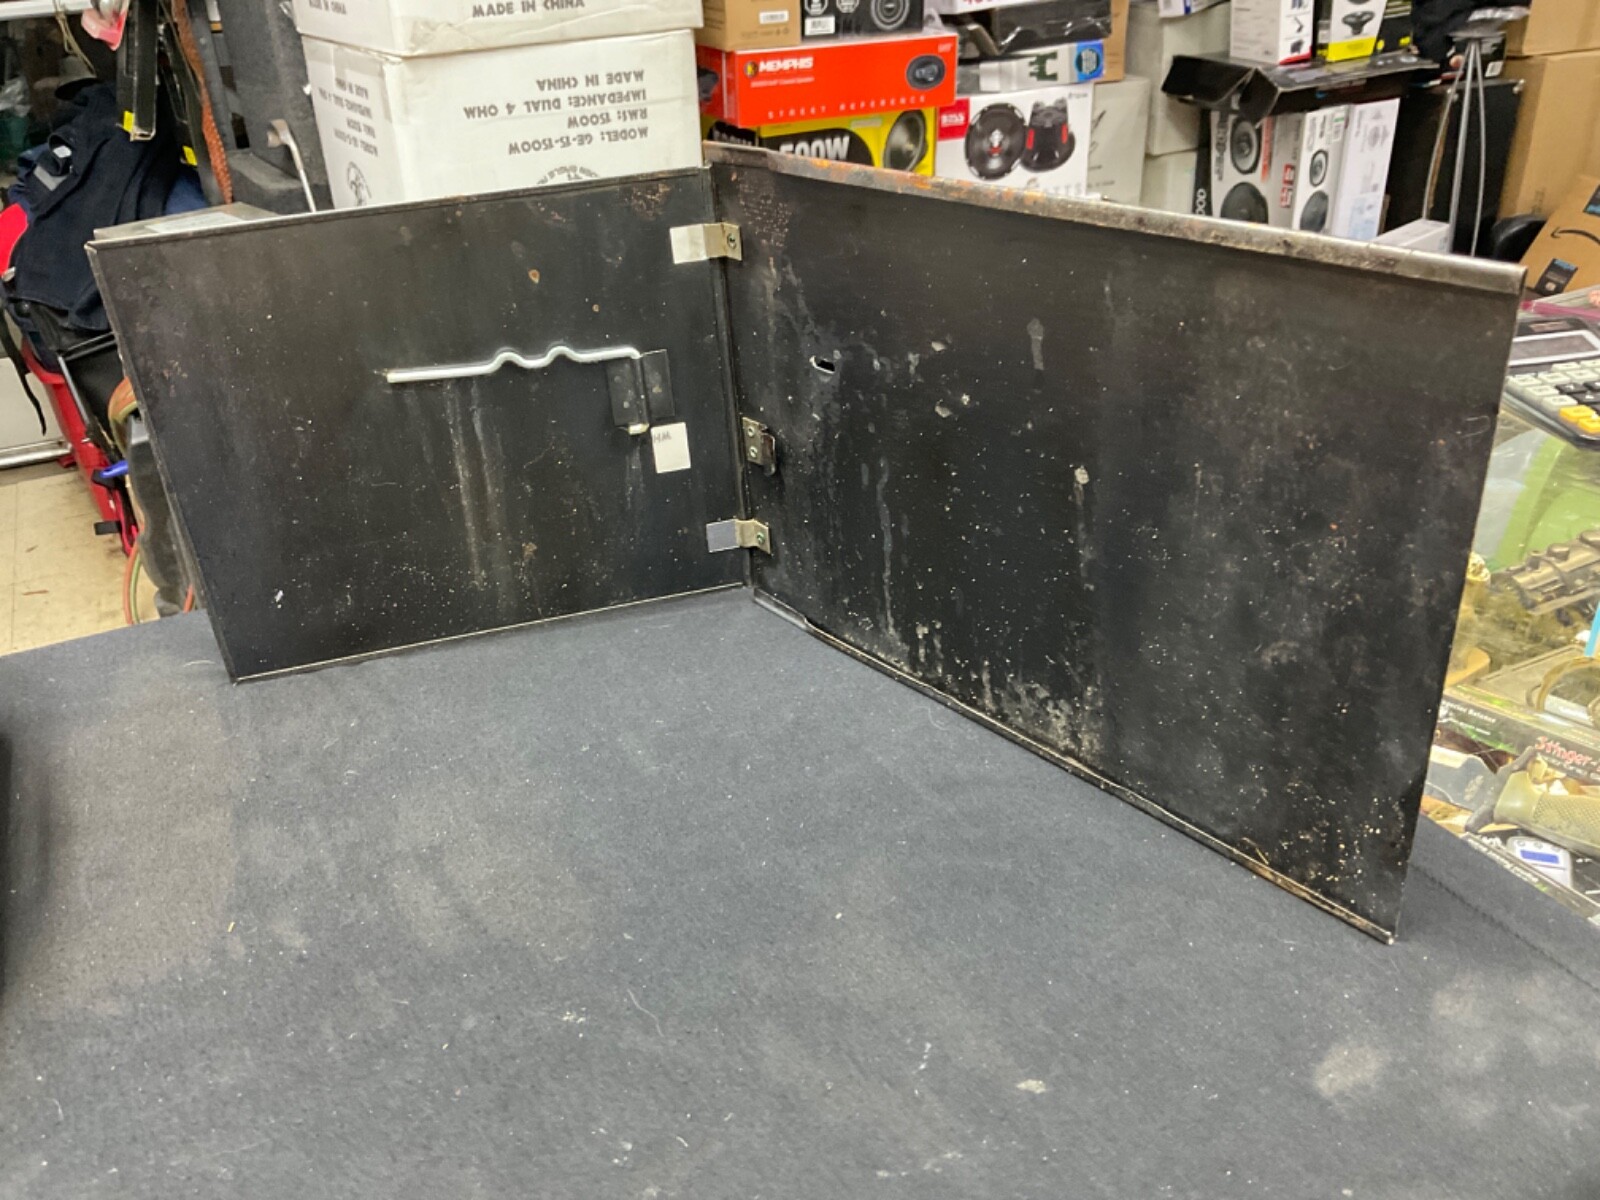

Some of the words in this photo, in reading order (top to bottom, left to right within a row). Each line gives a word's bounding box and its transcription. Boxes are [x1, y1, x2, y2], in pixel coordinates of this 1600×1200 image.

[472, 2, 514, 18] MADE
[521, 0, 536, 13] IN
[543, 0, 586, 10] CHINA
[759, 57, 814, 73] MEMPHIS
[536, 76, 578, 91] CHINA
[585, 74, 599, 87] IN
[606, 69, 645, 85] MADE
[524, 97, 561, 113] DUAL
[568, 89, 647, 108] IMPEDANCE:
[463, 104, 499, 119] OHM
[505, 103, 516, 116] 4
[617, 108, 648, 122] RMS:
[768, 105, 826, 119] STREET
[839, 95, 926, 111] REFERENCE
[567, 112, 612, 129] 1500W
[601, 126, 649, 142] MODEL:
[508, 133, 593, 155] GE-15-1500W
[1534, 735, 1600, 772] Stinger-
